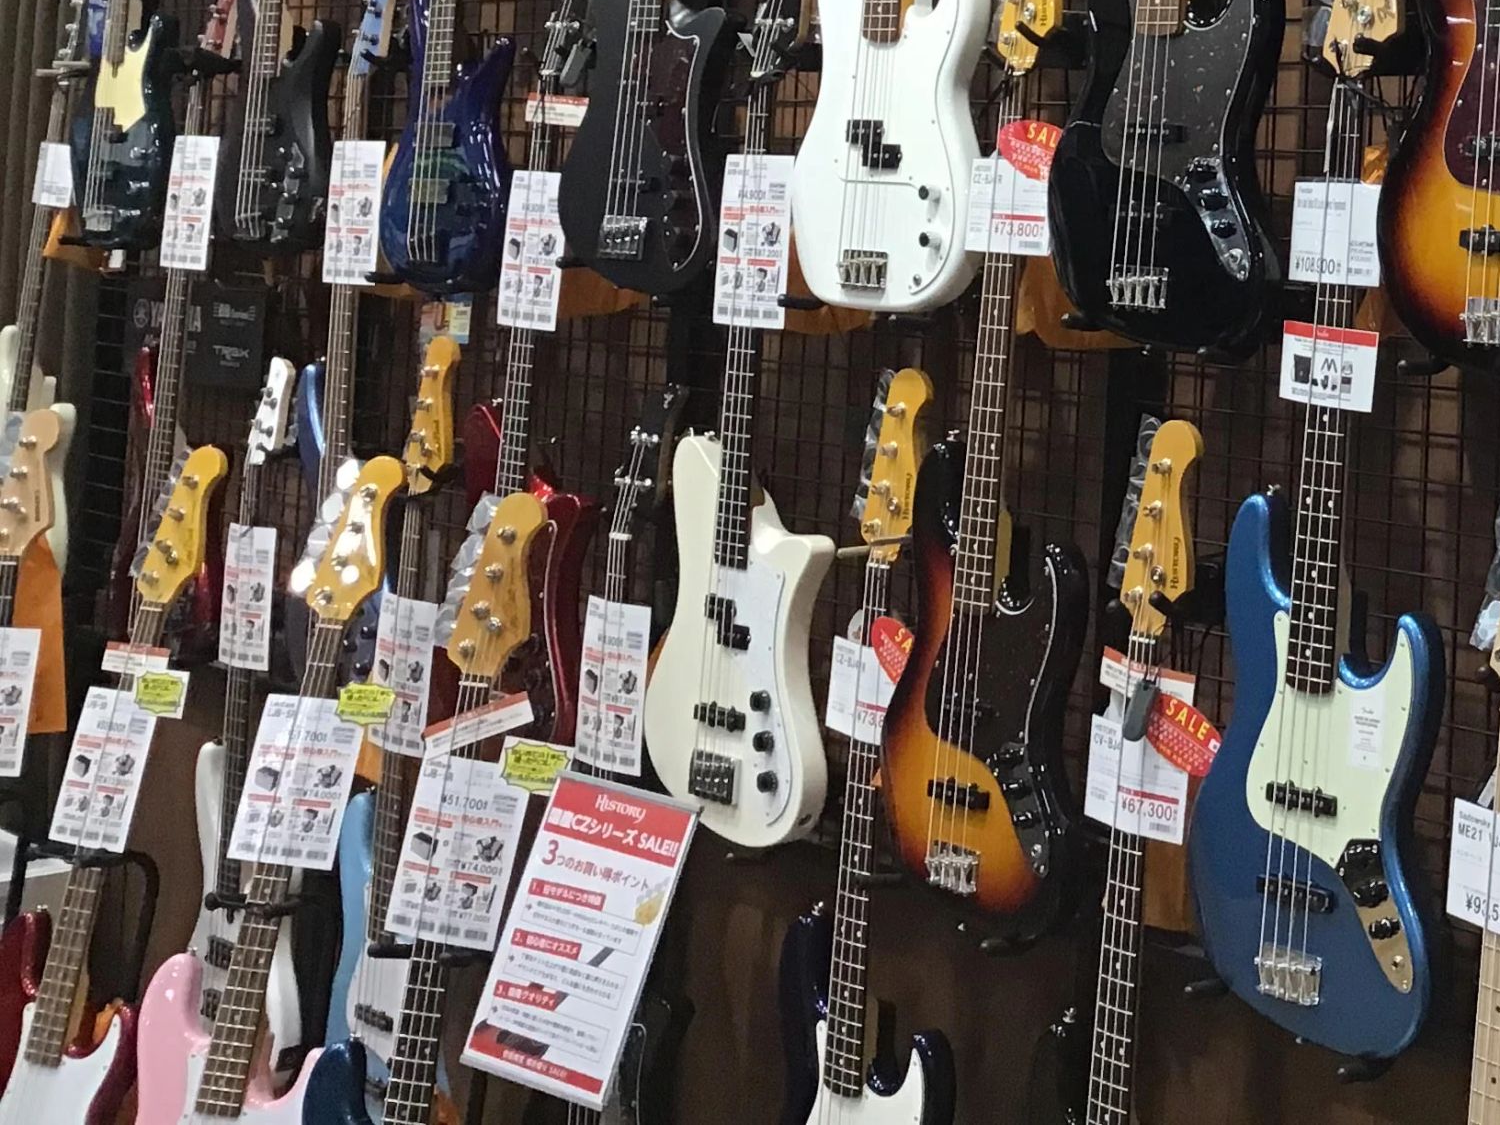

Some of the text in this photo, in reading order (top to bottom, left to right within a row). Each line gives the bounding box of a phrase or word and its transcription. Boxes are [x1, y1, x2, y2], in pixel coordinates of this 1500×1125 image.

[1027, 123, 1058, 147] SAL
[1166, 699, 1210, 739] SALE
[595, 794, 647, 824] HISTORY
